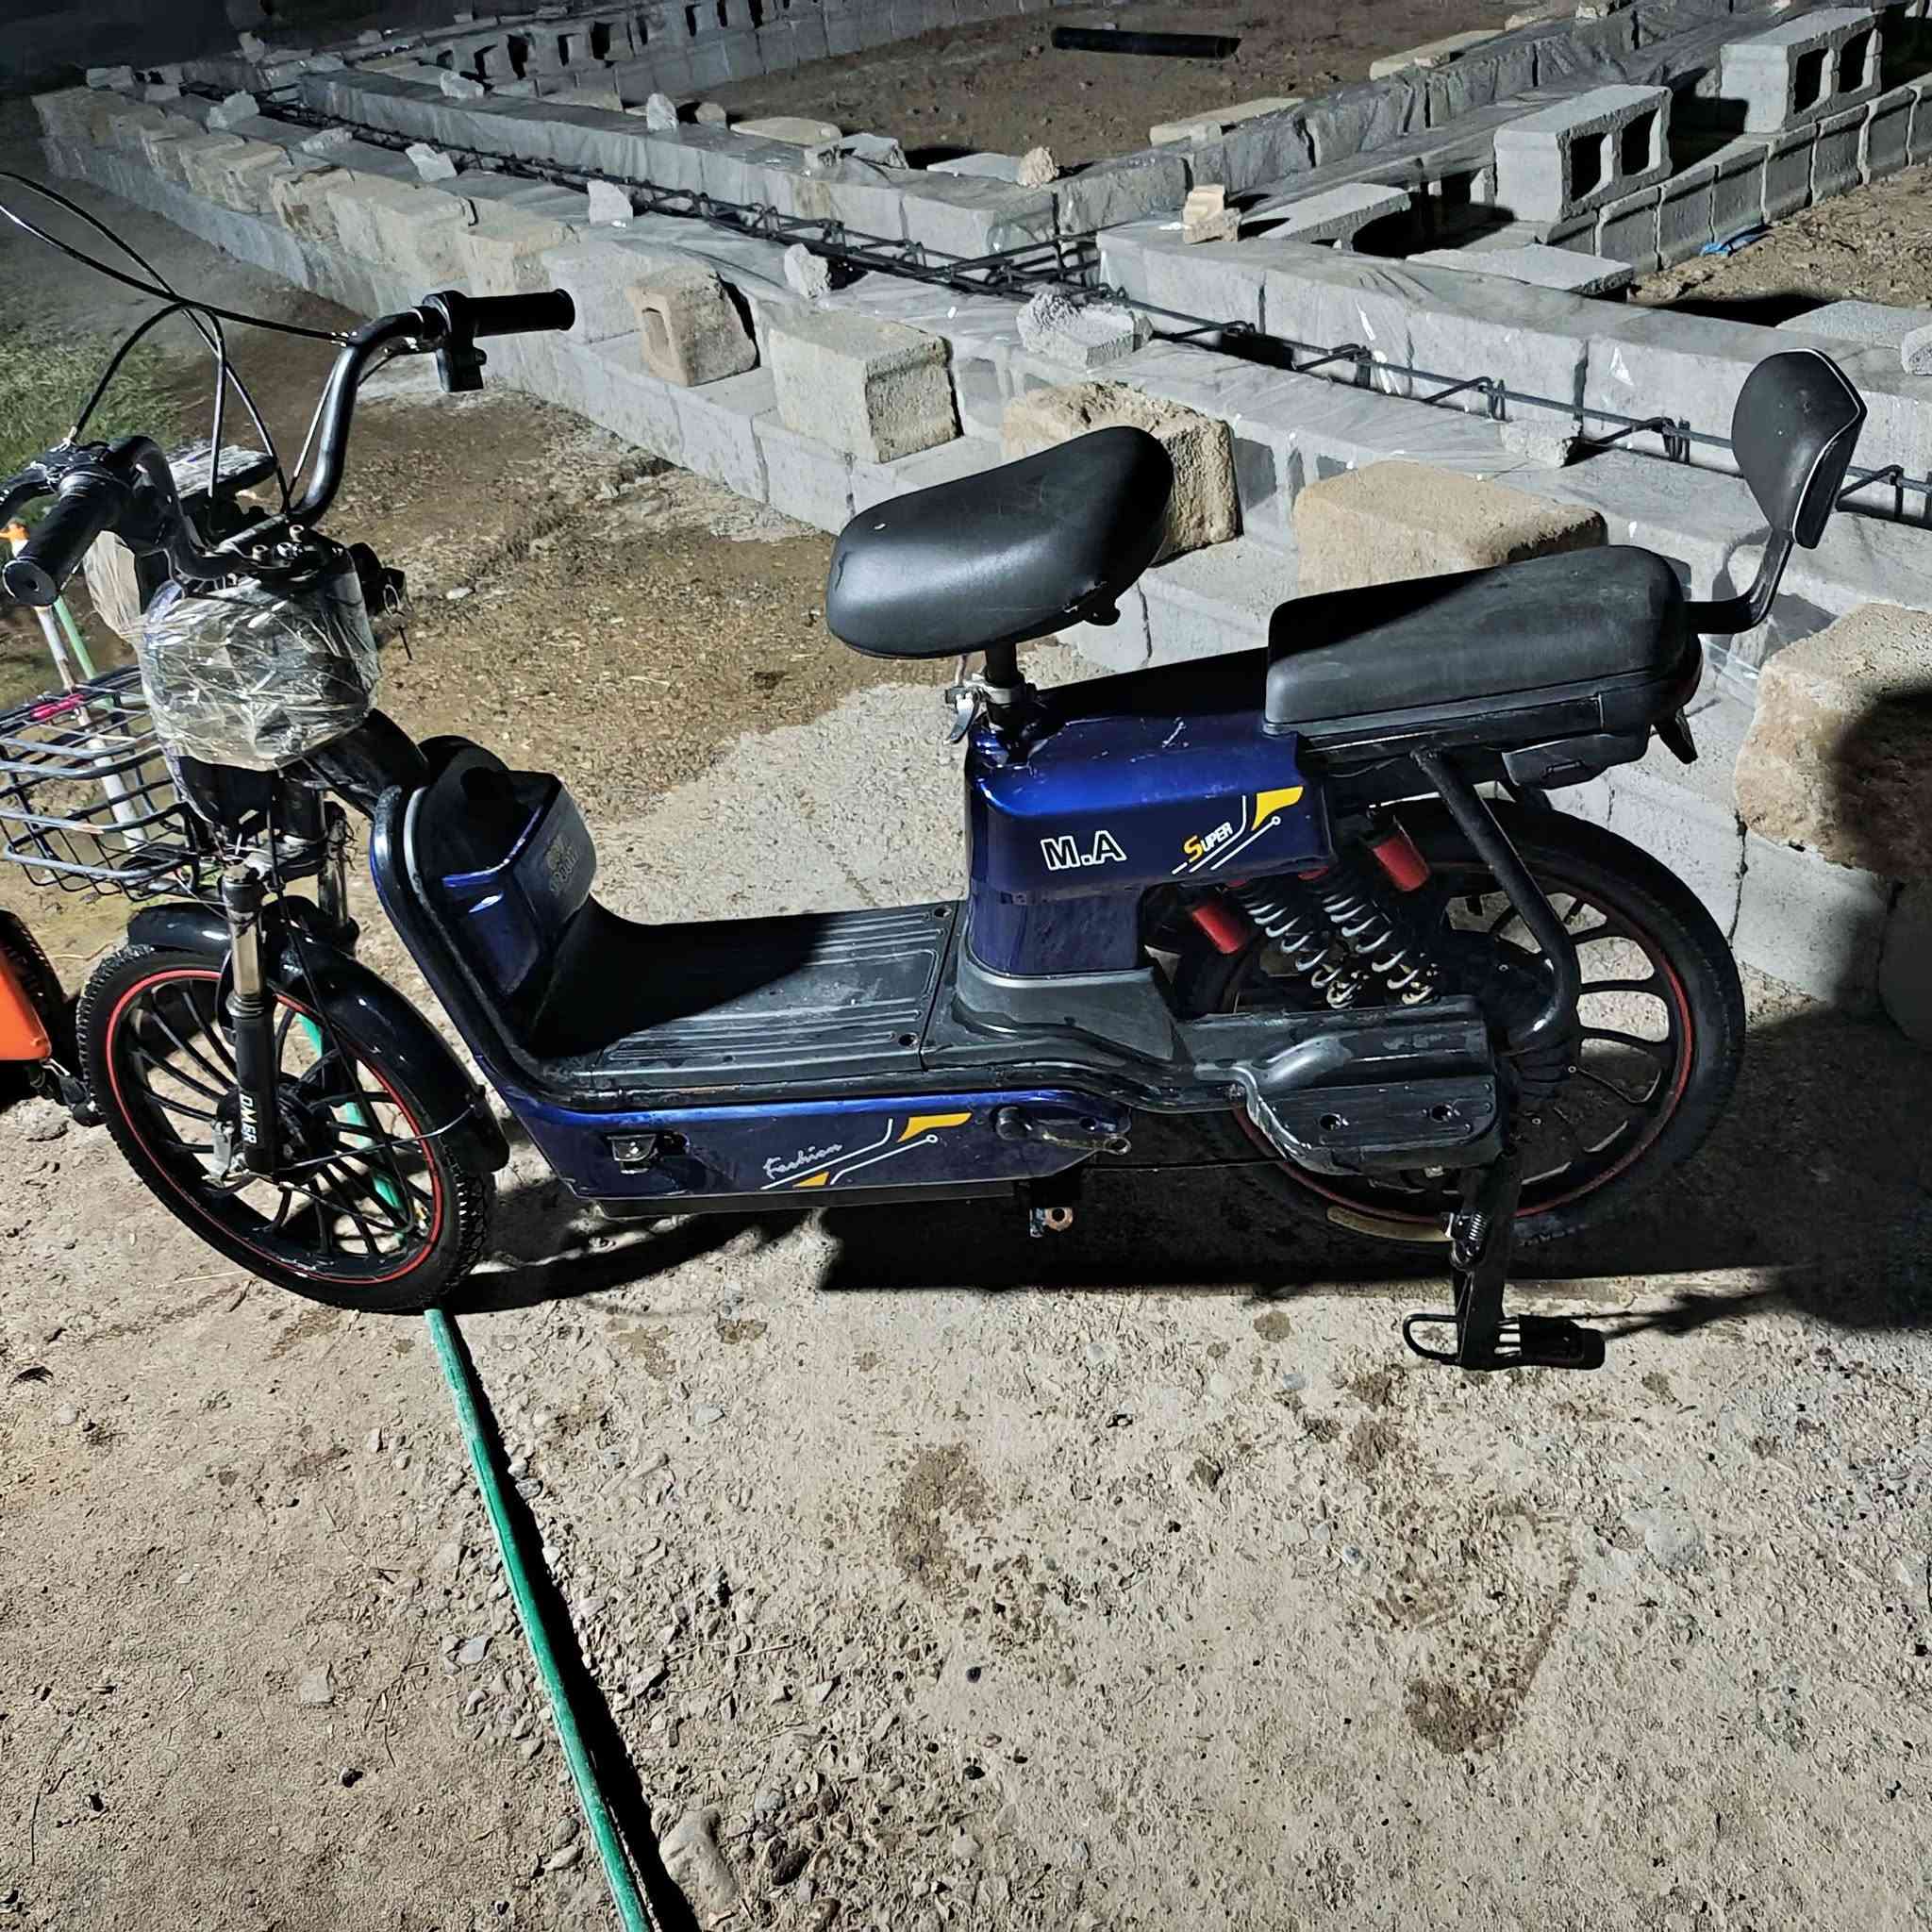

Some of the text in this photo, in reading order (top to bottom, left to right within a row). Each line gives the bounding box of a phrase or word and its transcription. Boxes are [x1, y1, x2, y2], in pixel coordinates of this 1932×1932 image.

[1041, 830, 1126, 870] M.A
[1183, 822, 1233, 863] SUPER
[762, 1143, 843, 1180] Fashion
